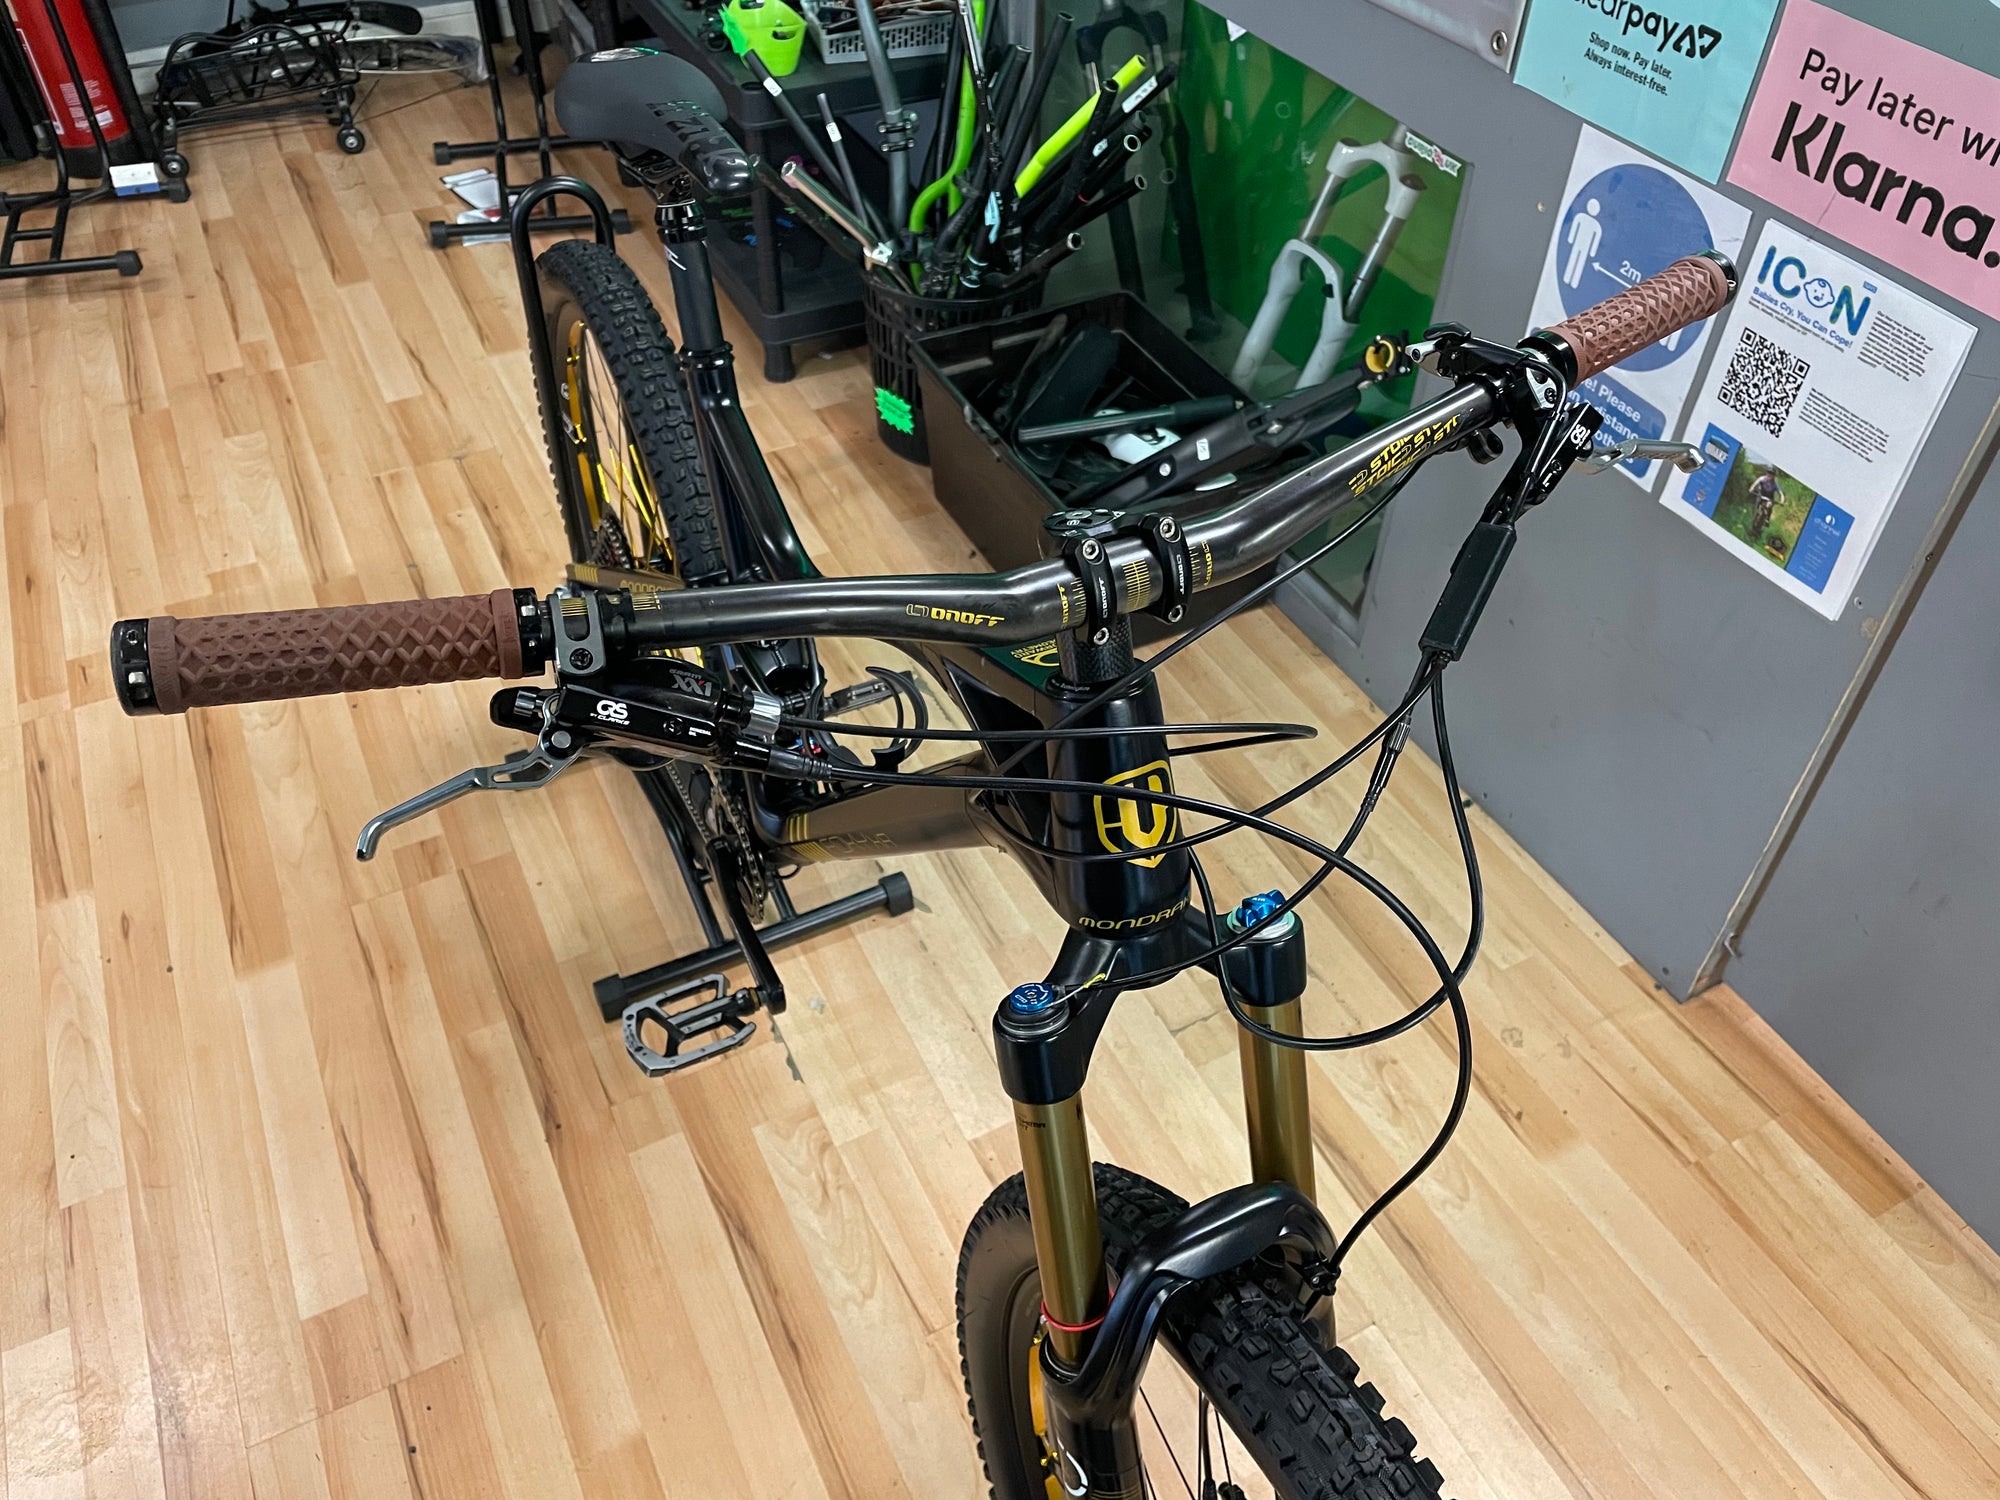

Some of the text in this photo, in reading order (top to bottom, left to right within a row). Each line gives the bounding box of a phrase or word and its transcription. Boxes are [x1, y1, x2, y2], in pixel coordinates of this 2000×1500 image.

[1584, 48, 1668, 96] Always interest-free.
[1589, 32, 1672, 80] Shop now. Pay later.
[1800, 48, 1864, 106] Pay
[1867, 77, 1954, 141] later
[1771, 101, 2000, 269] Klarna.
[1619, 260, 1642, 283] 2m
[1753, 286, 1779, 307] Babies
[1797, 310, 1812, 325] You
[1812, 320, 1829, 334] Can
[1829, 330, 1853, 347] Cope!
[1598, 385, 1642, 423] Please
[1079, 897, 1188, 930] MONDRA
